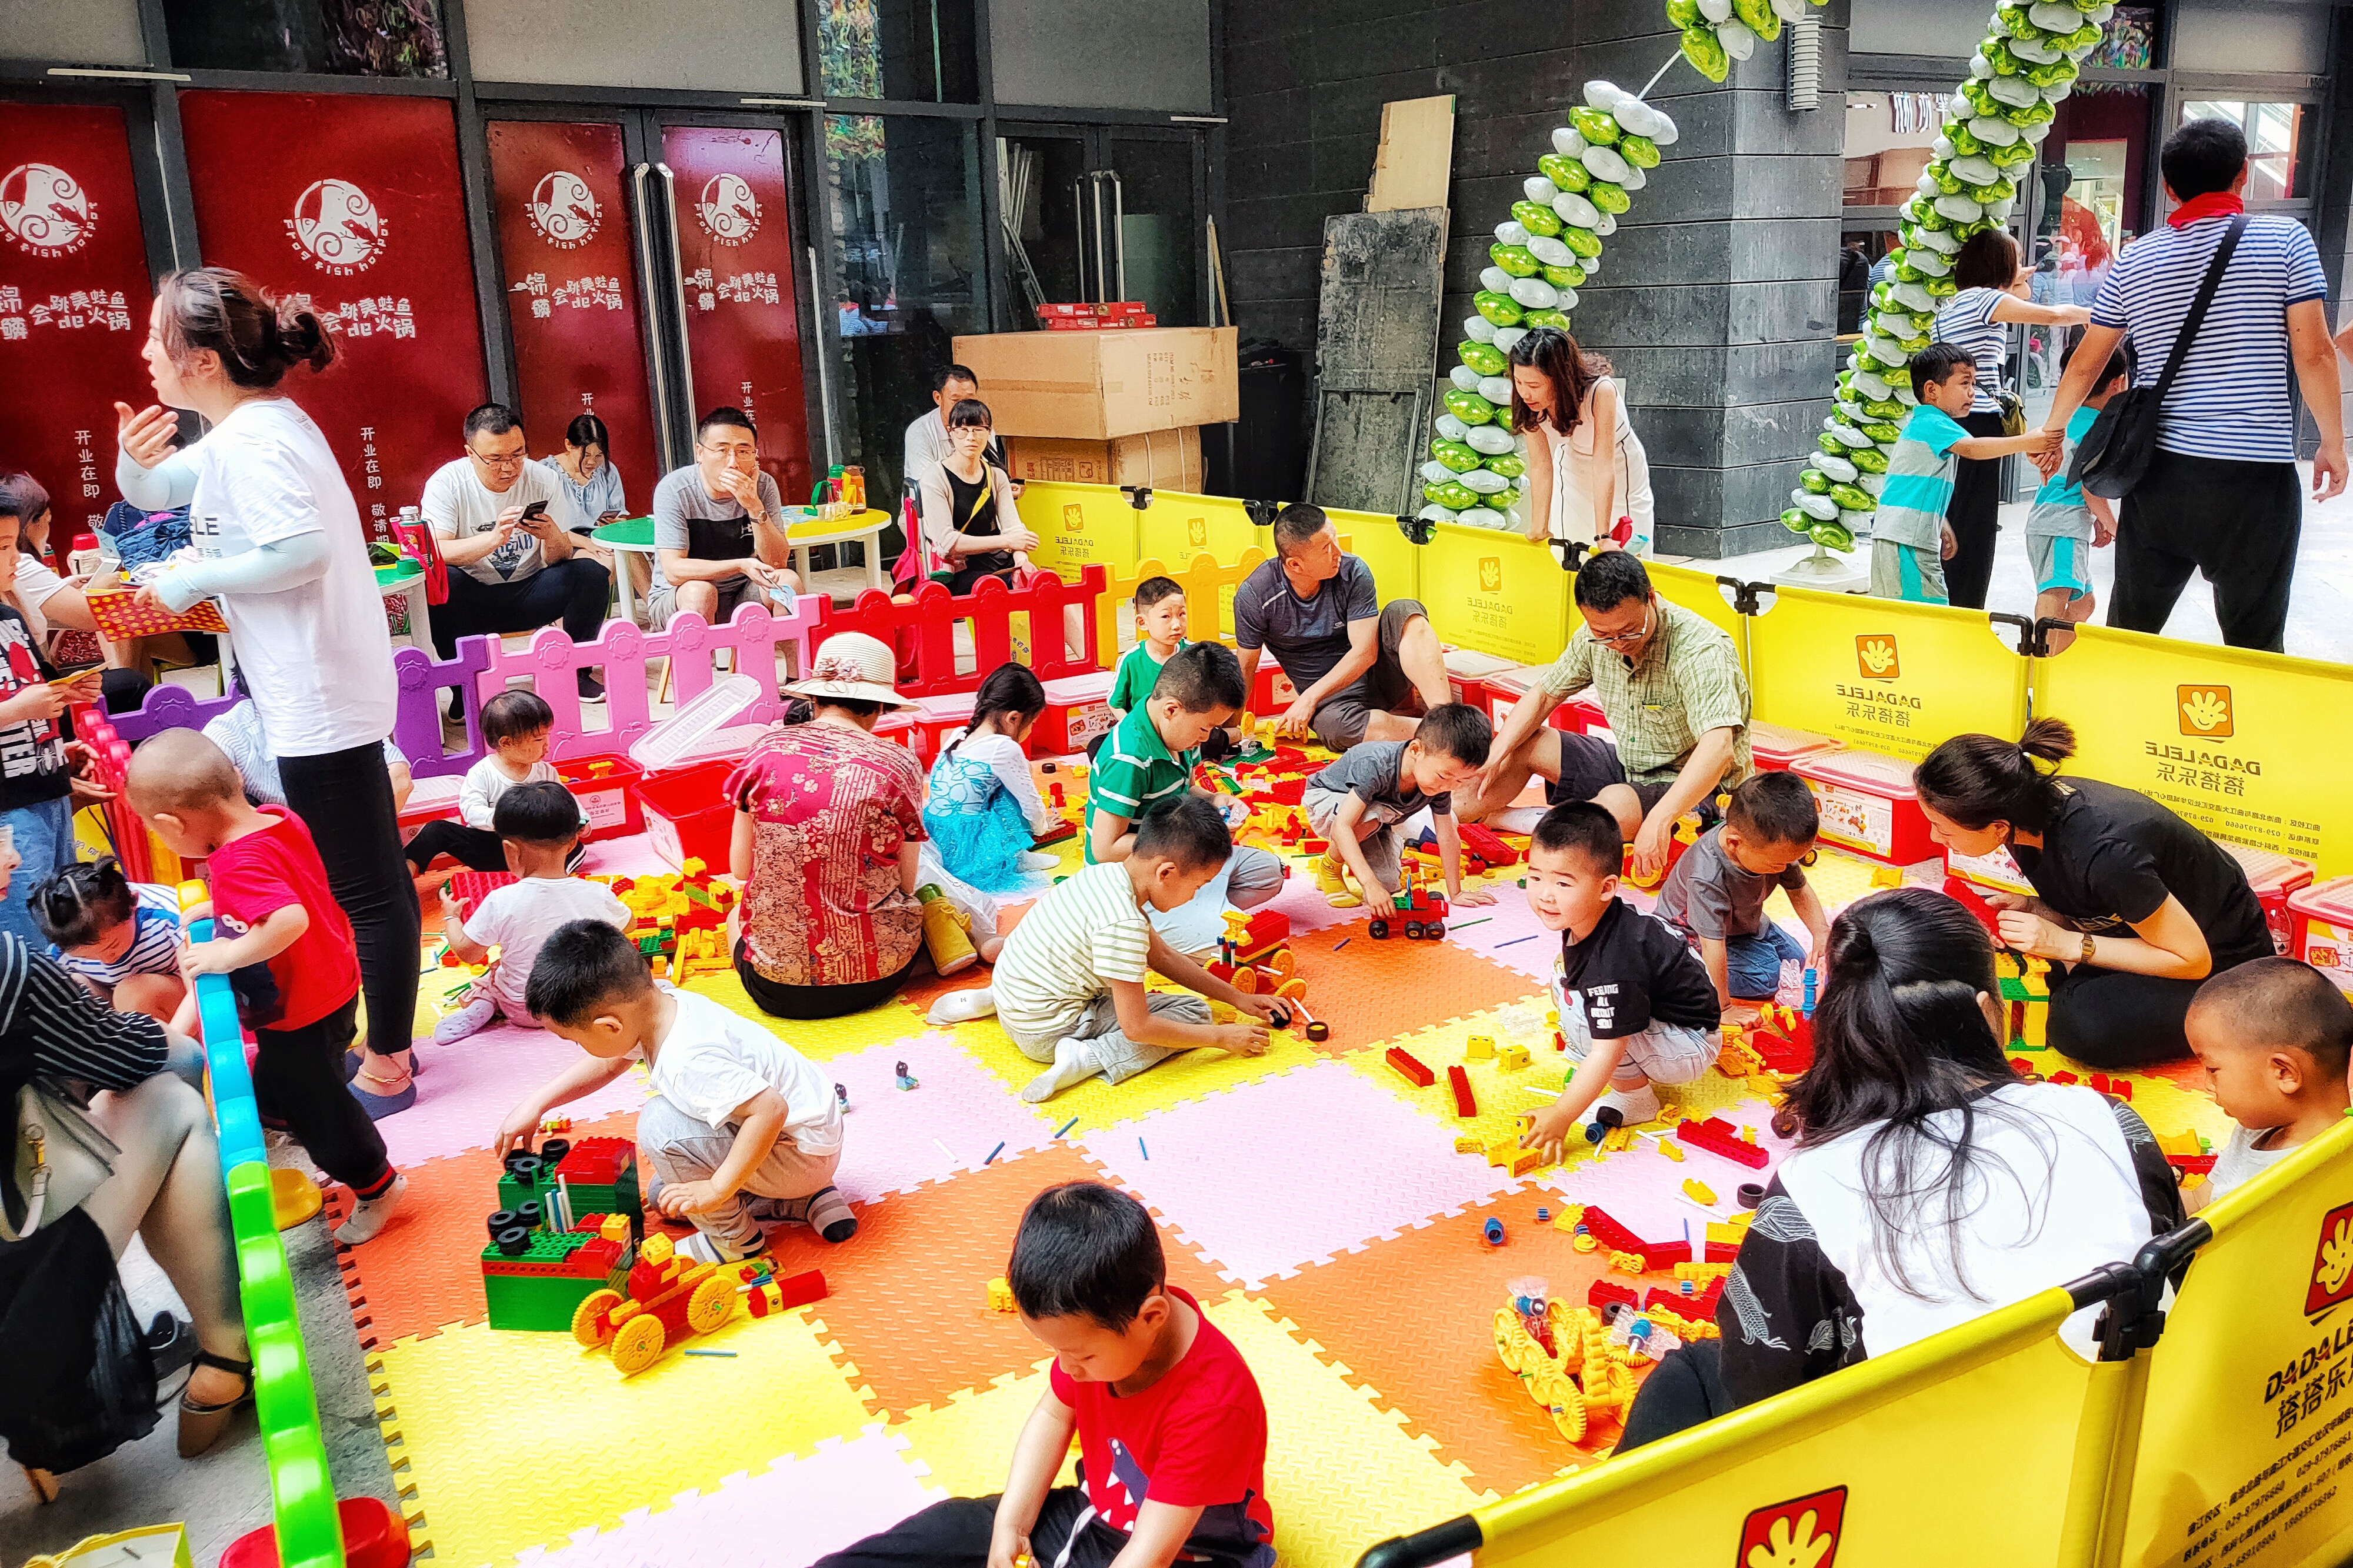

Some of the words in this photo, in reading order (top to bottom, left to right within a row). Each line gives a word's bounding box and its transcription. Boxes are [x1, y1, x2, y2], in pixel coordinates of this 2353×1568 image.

[20, 242, 62, 258] fish
[284, 219, 312, 261] Frog
[315, 261, 354, 276] fish
[358, 218, 389, 272] hotpot
[524, 203, 545, 236] Frog
[547, 236, 576, 249] fish
[714, 235, 739, 247] fish
[741, 381, 757, 429] 开业在
[74, 430, 100, 498] 开业在即
[360, 427, 382, 489] 开业在即
